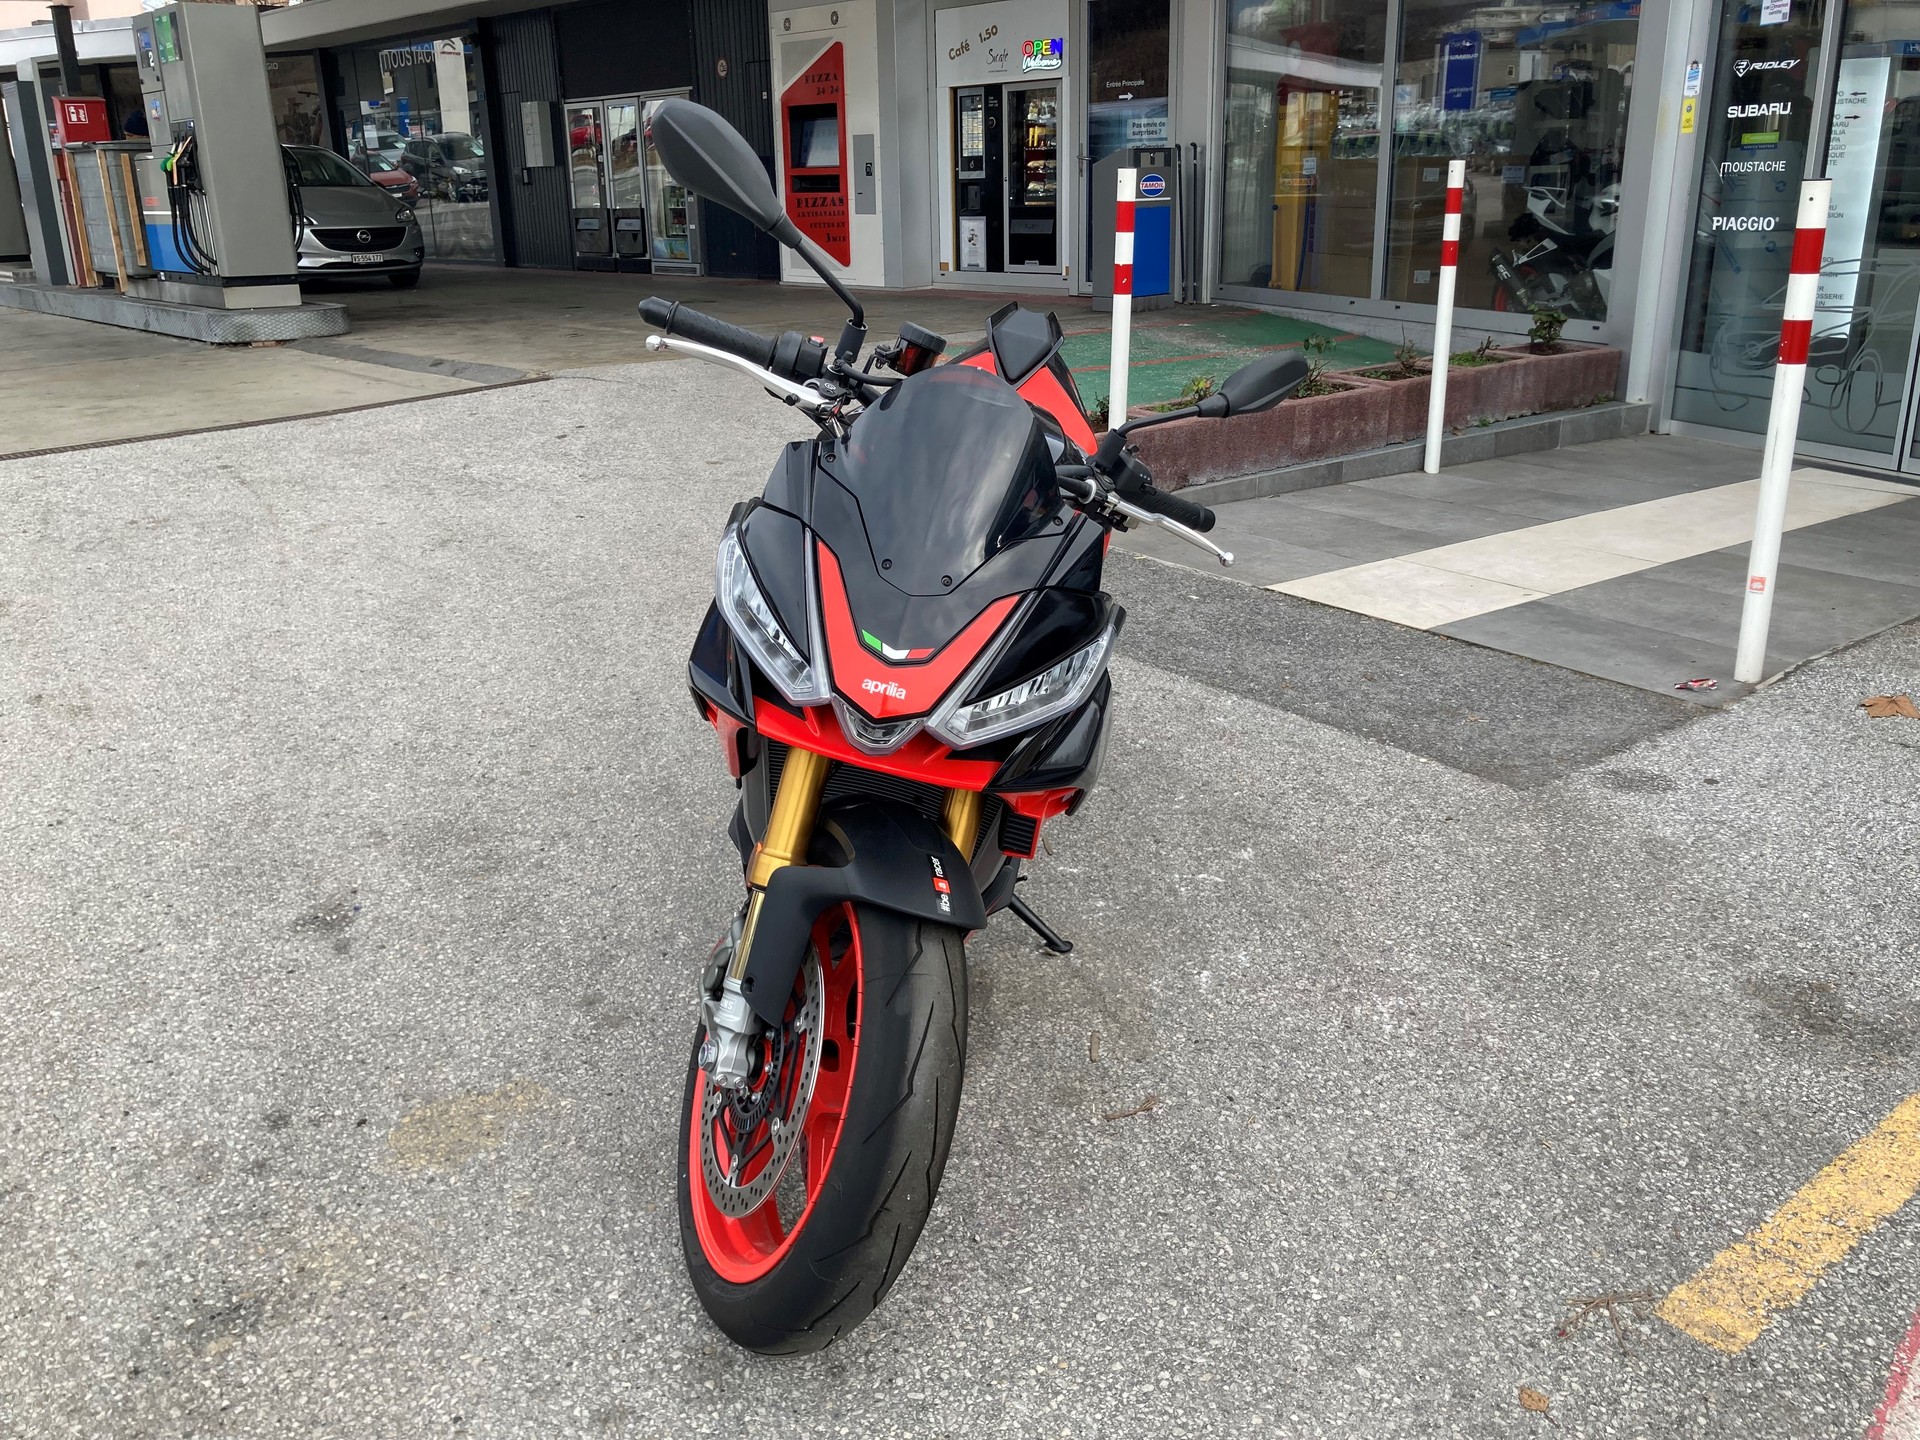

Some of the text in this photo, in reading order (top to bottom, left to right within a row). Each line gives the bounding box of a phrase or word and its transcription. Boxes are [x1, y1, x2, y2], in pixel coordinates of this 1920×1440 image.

[979, 25, 998, 43] 1.50
[948, 39, 970, 60] Café
[1022, 38, 1063, 57] OPEN
[148, 51, 154, 67] 2
[1749, 59, 1801, 71] RIDLEY
[805, 72, 838, 84] PIZZA
[1727, 102, 1792, 118] SUBARU
[1720, 160, 1787, 176] MOUSTACHE
[796, 196, 844, 208] PIZZAS
[1712, 216, 1776, 231] PIAGGIO
[862, 678, 906, 700] aprilia
[931, 855, 951, 912] #be a racer
